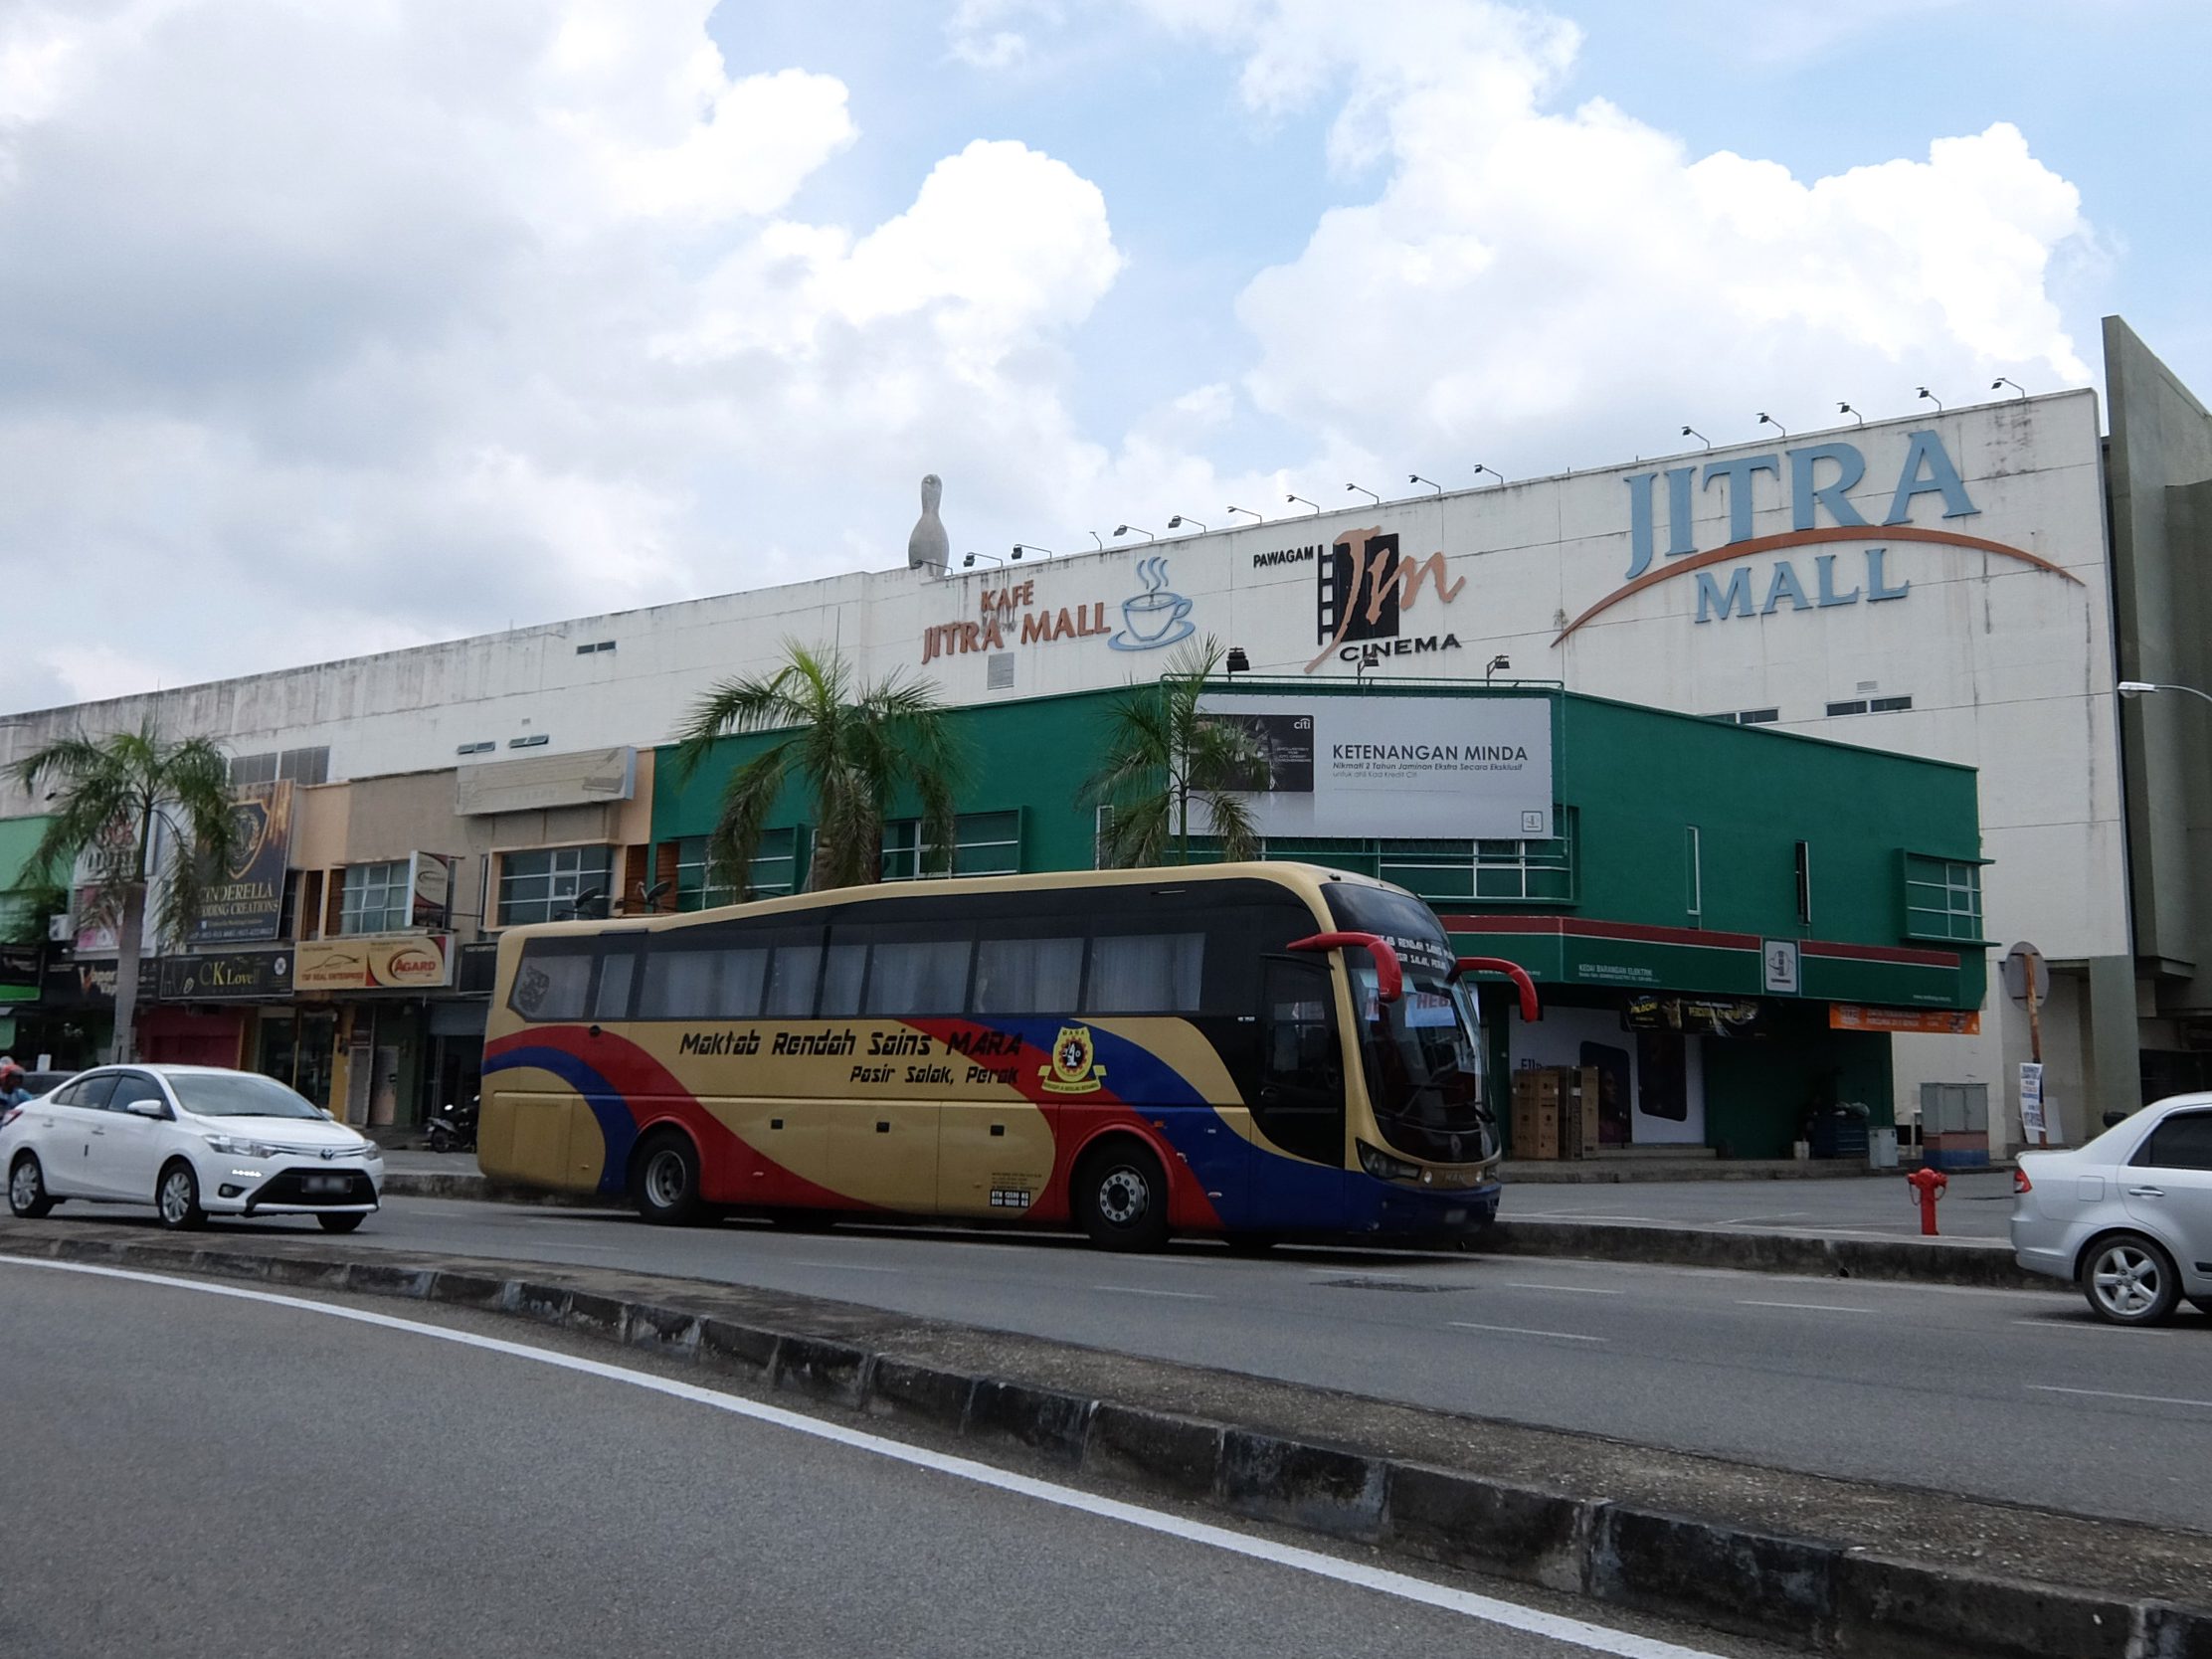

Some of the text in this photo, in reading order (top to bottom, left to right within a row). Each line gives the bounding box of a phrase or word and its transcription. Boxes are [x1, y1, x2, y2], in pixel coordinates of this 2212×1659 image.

[1623, 429, 1982, 579] JITRA
[1253, 545, 1314, 569] PAWAGAM
[1695, 548, 1910, 624] MALL
[1020, 602, 1112, 645] MALL
[921, 618, 1005, 664] JITRA
[1340, 633, 1462, 662] CINEMA
[1294, 718, 1311, 729] citi
[1333, 744, 1529, 761] KETENANGAN MINDA
[679, 1028, 1023, 1057] Maktab Rendah Sains MARA
[850, 1064, 1018, 1085] Pasir Salak, Perak
